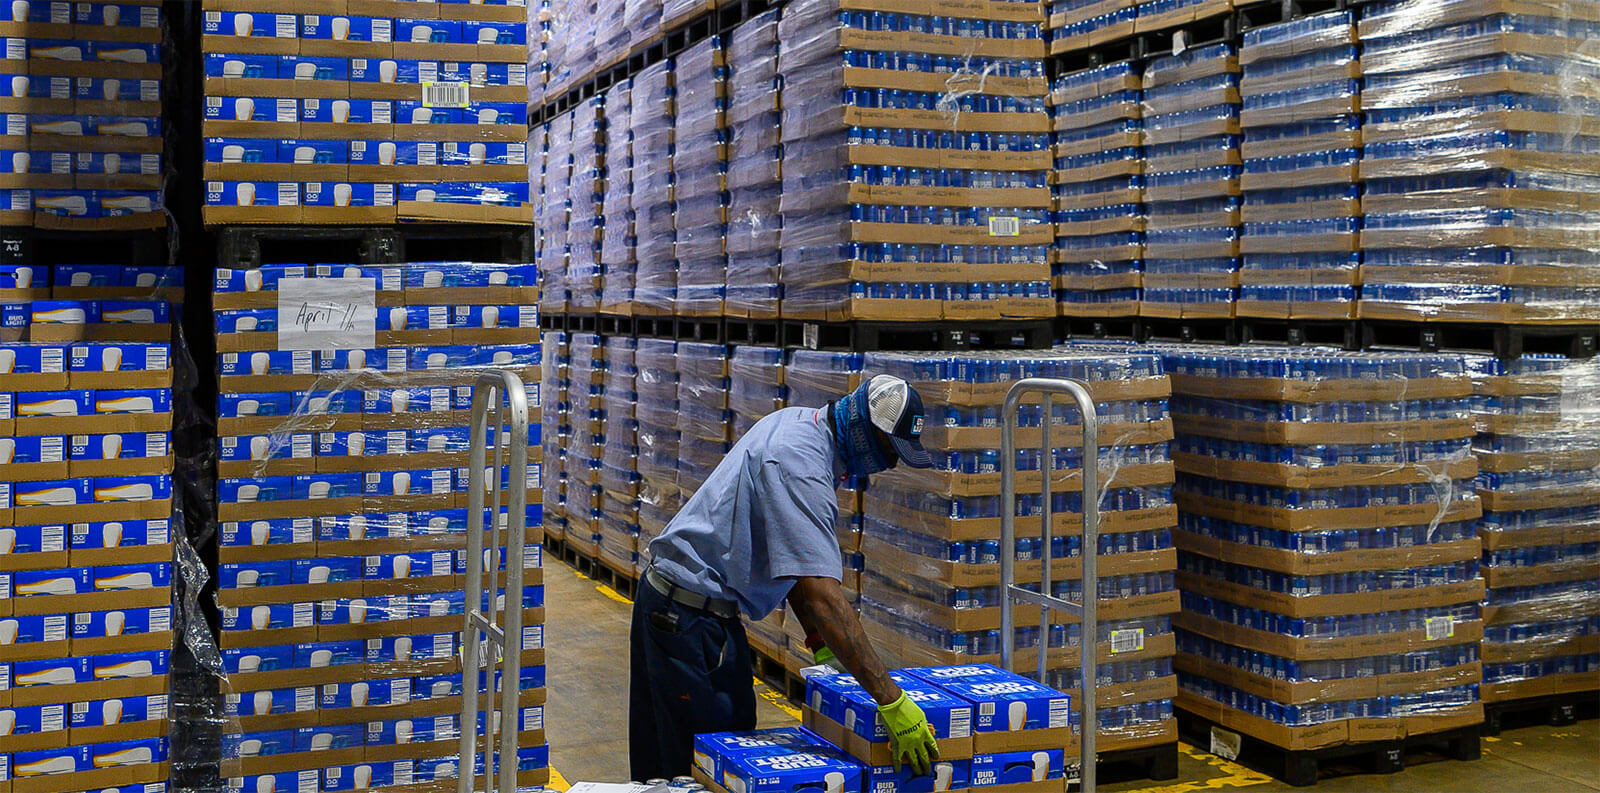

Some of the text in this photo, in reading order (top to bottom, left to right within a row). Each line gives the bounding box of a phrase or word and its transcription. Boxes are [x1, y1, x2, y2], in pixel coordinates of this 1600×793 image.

[295, 302, 332, 333] April
[930, 669, 997, 677] LIGHT
[969, 685, 1039, 695] LIGHT
[770, 759, 828, 770] BUD
[977, 770, 995, 779] BUD
[974, 776, 997, 785] LIGHT
[876, 781, 895, 790] BUD
